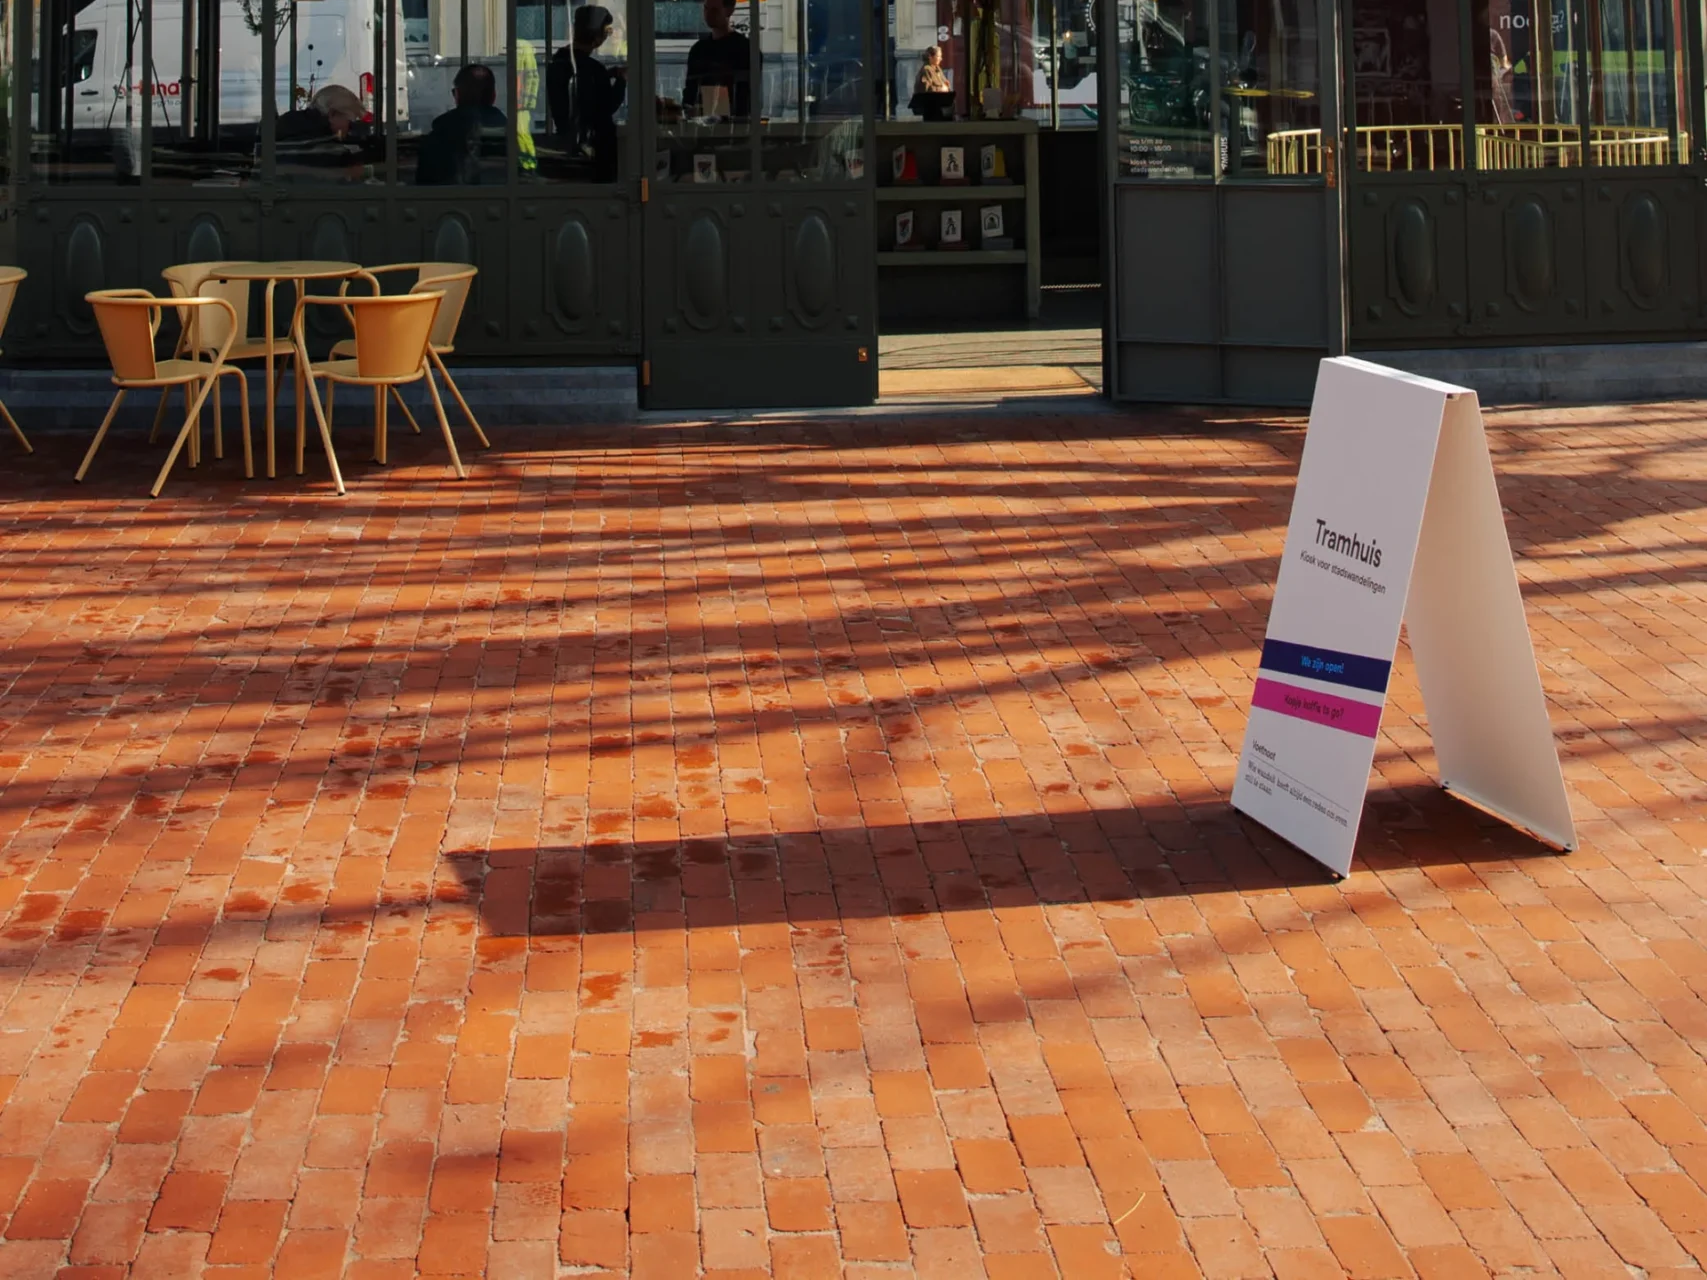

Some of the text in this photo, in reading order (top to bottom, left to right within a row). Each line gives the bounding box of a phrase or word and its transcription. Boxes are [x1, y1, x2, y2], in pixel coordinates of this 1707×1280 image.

[1315, 518, 1382, 568] Tramhuis
[1300, 550, 1386, 595] Kiosk voor stadswandelingen
[1301, 655, 1345, 674] We zijn open!
[1322, 705, 1330, 715] to
[1330, 707, 1345, 720] go?
[1253, 739, 1276, 760] Voetnoot
